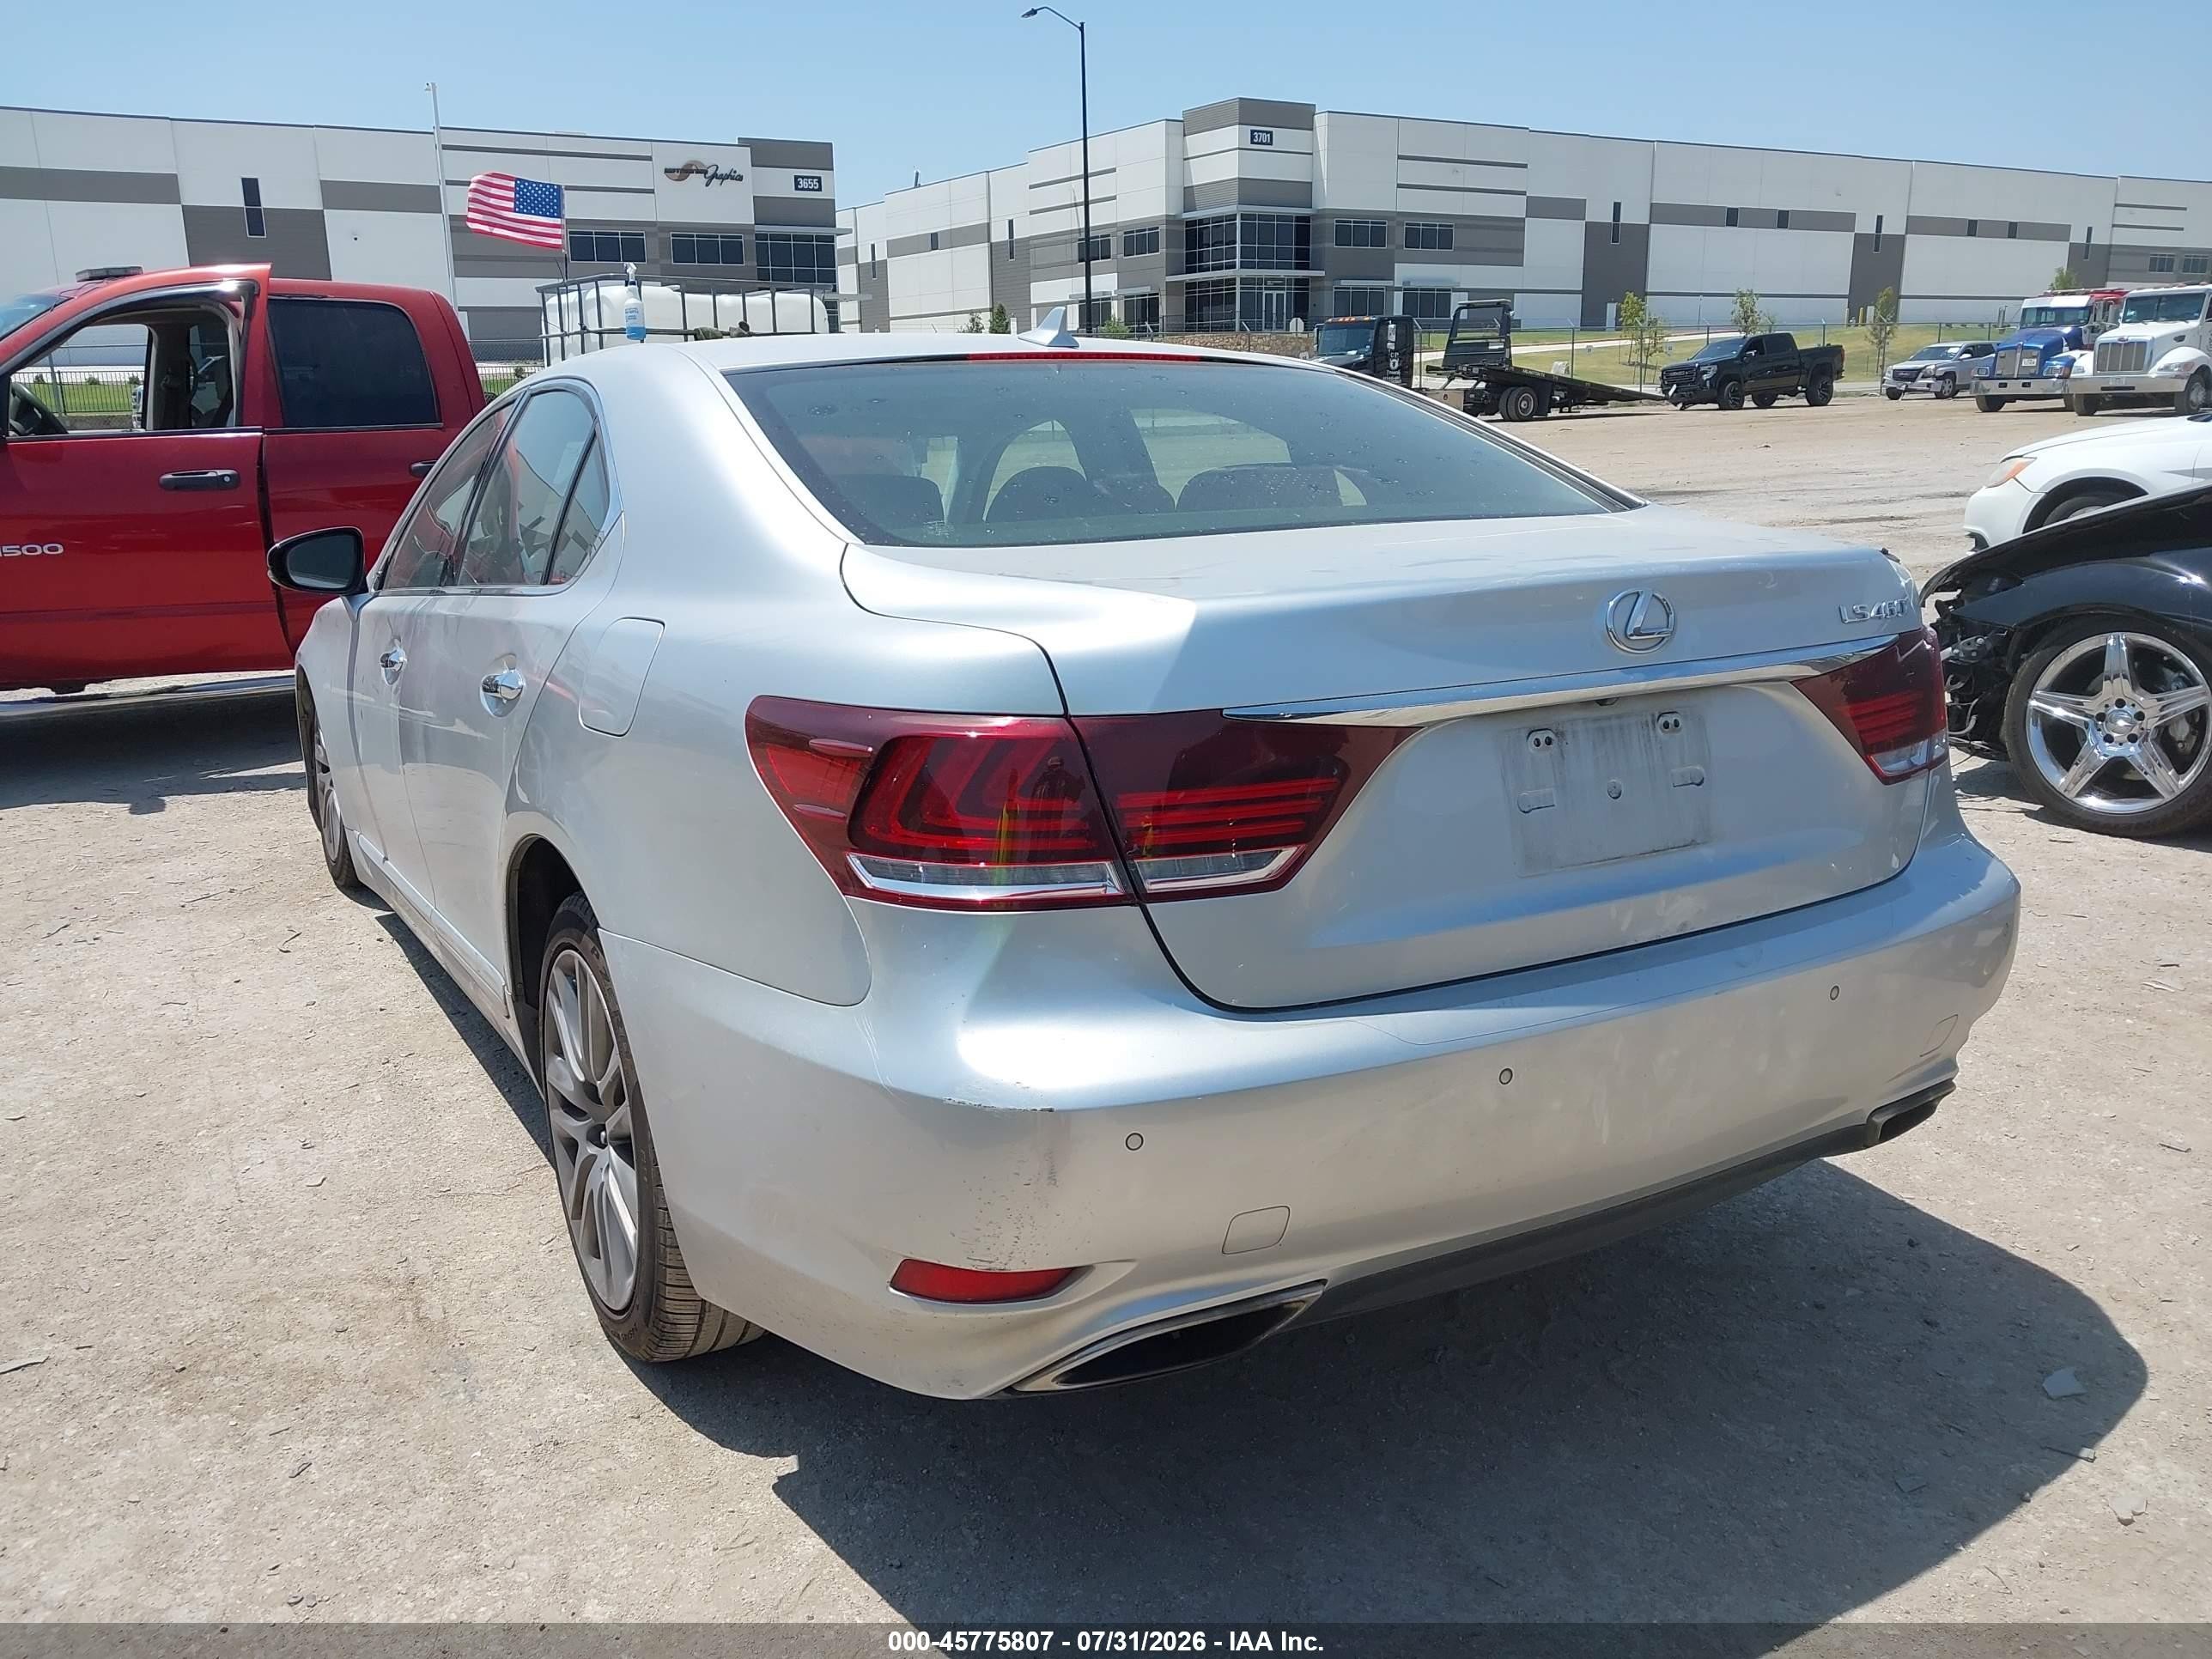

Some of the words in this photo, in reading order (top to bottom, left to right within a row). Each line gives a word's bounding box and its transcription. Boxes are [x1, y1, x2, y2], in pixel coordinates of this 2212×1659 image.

[1253, 131, 1271, 143] 3701
[703, 164, 744, 187] Graphics
[797, 178, 819, 190] 3655
